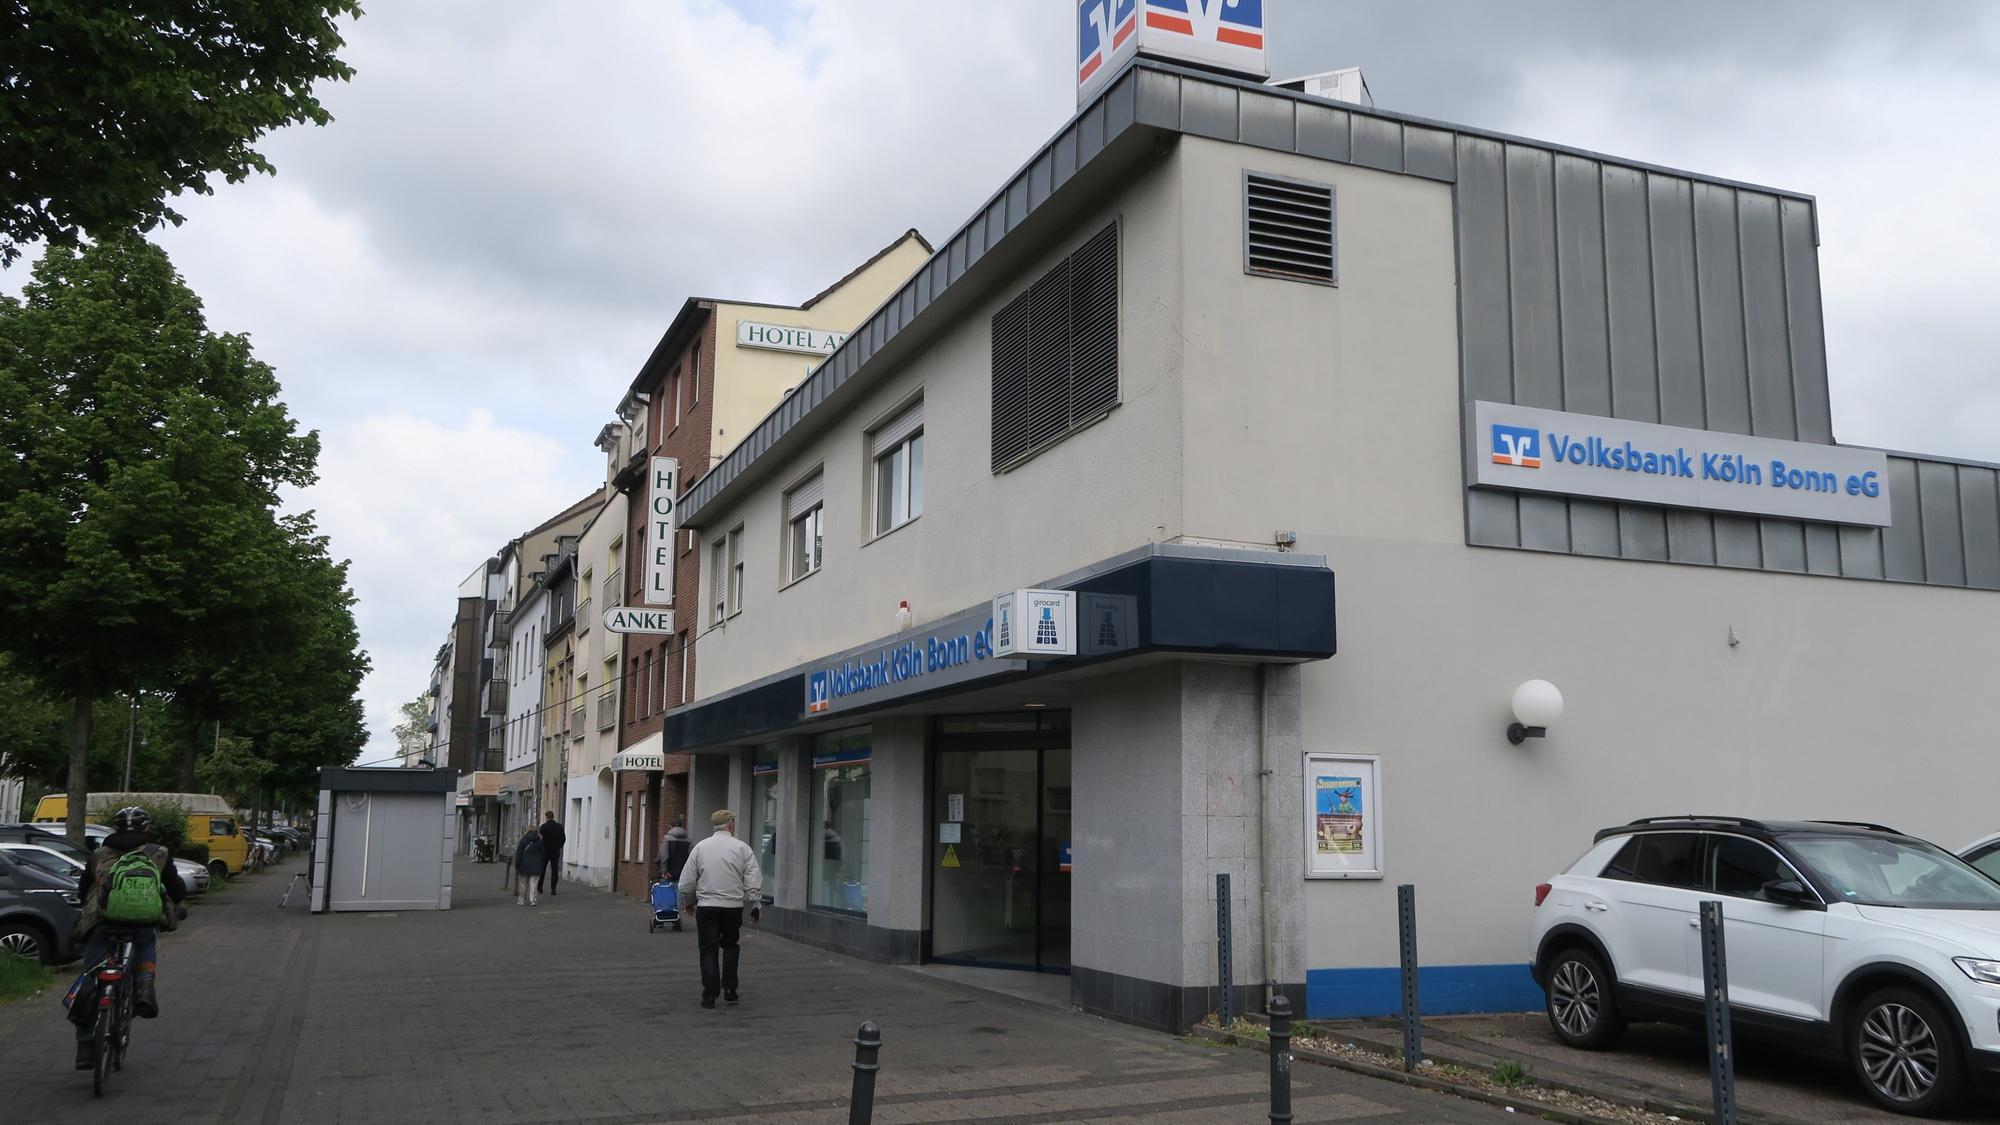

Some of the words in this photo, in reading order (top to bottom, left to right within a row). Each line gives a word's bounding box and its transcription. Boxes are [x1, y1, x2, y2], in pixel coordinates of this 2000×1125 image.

[749, 326, 816, 348] HOTEL
[1547, 432, 1694, 478] Volksbank
[1701, 452, 1762, 485] Köln
[1770, 460, 1837, 493] Bonn
[1845, 470, 1879, 497] eG
[654, 471, 673, 591] HOTEL
[1033, 599, 1060, 608] girocard
[612, 611, 668, 630] ANKE
[829, 650, 889, 699] Volksbank
[891, 640, 924, 682] Köln
[927, 634, 969, 673] Bonn
[625, 757, 663, 767] HOTEL
